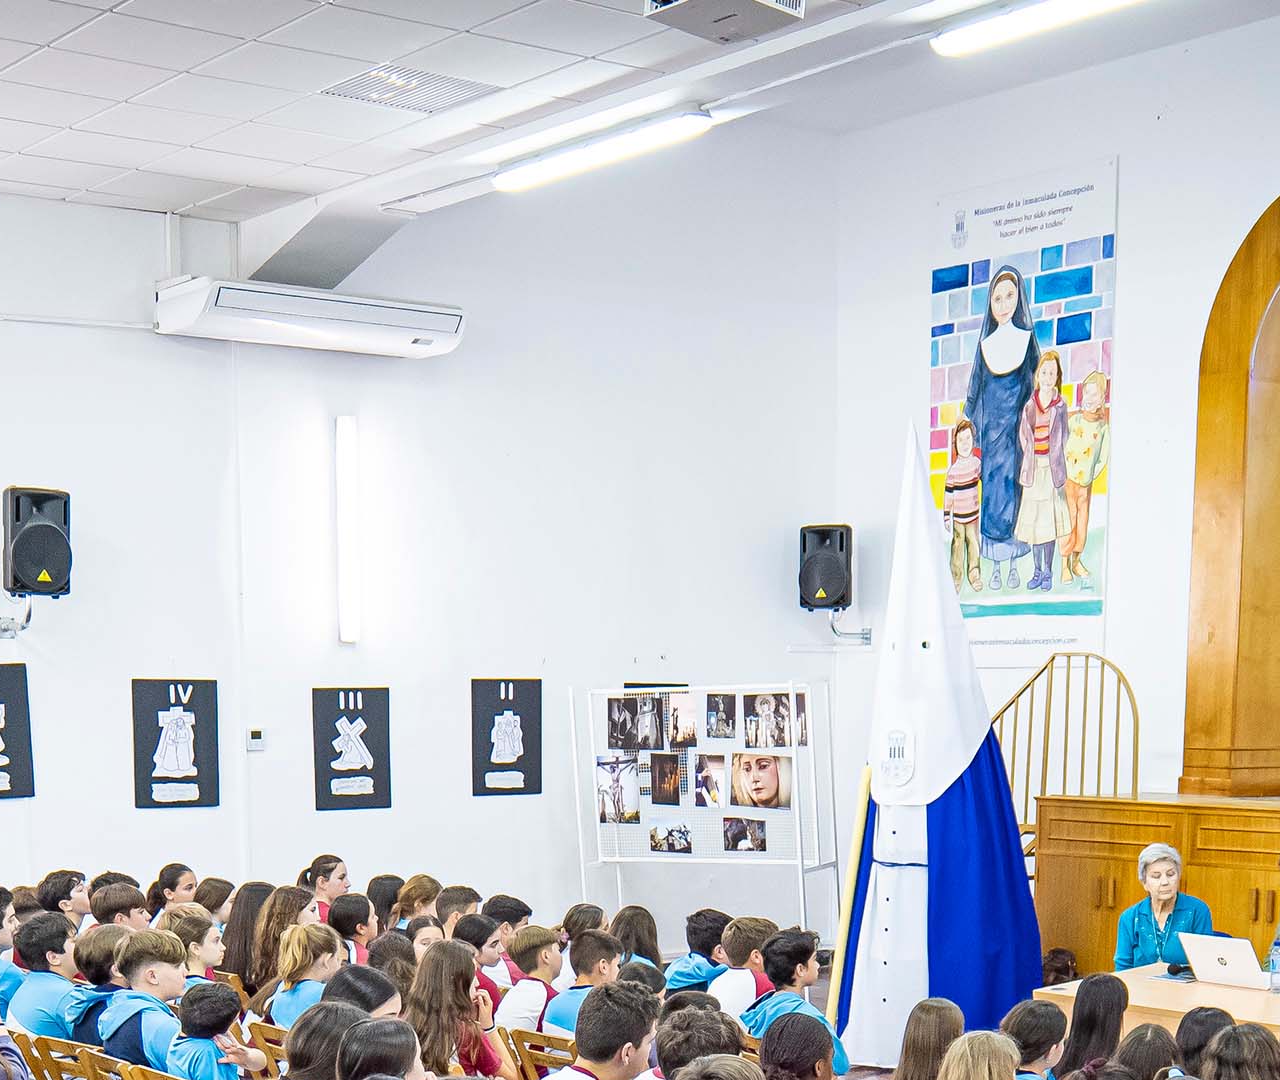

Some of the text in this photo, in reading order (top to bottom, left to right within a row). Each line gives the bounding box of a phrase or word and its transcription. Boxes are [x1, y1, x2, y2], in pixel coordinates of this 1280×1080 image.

[974, 204, 1005, 216] Misioneras
[168, 683, 193, 704] IV
[338, 690, 363, 711] III
[499, 681, 514, 701] II
